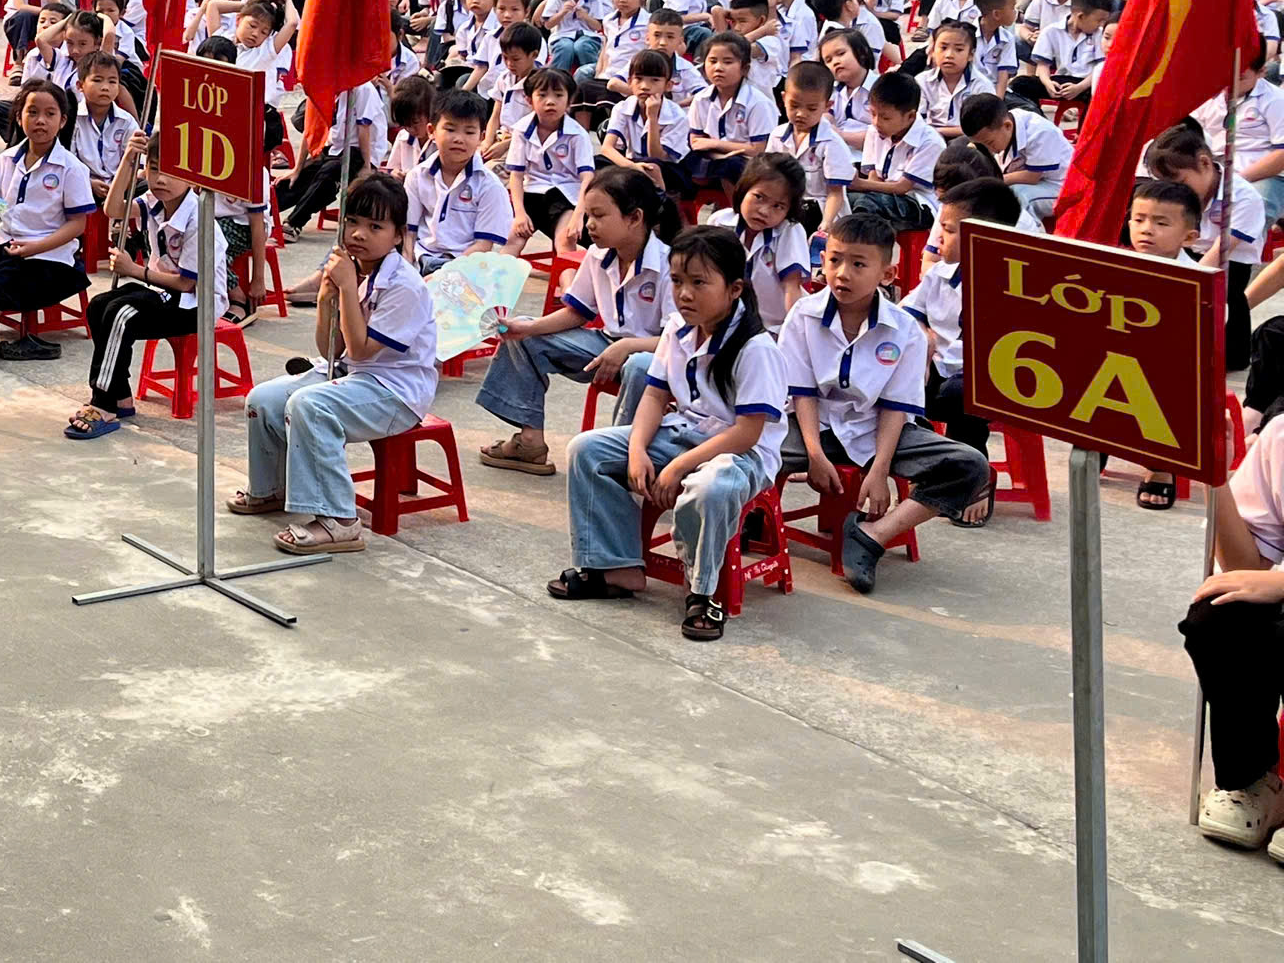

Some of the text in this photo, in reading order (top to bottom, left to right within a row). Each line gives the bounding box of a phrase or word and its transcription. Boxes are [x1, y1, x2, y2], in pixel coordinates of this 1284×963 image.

[174, 122, 235, 181] 1D
[1003, 258, 1161, 333] Lớp
[988, 330, 1181, 449] 6A
